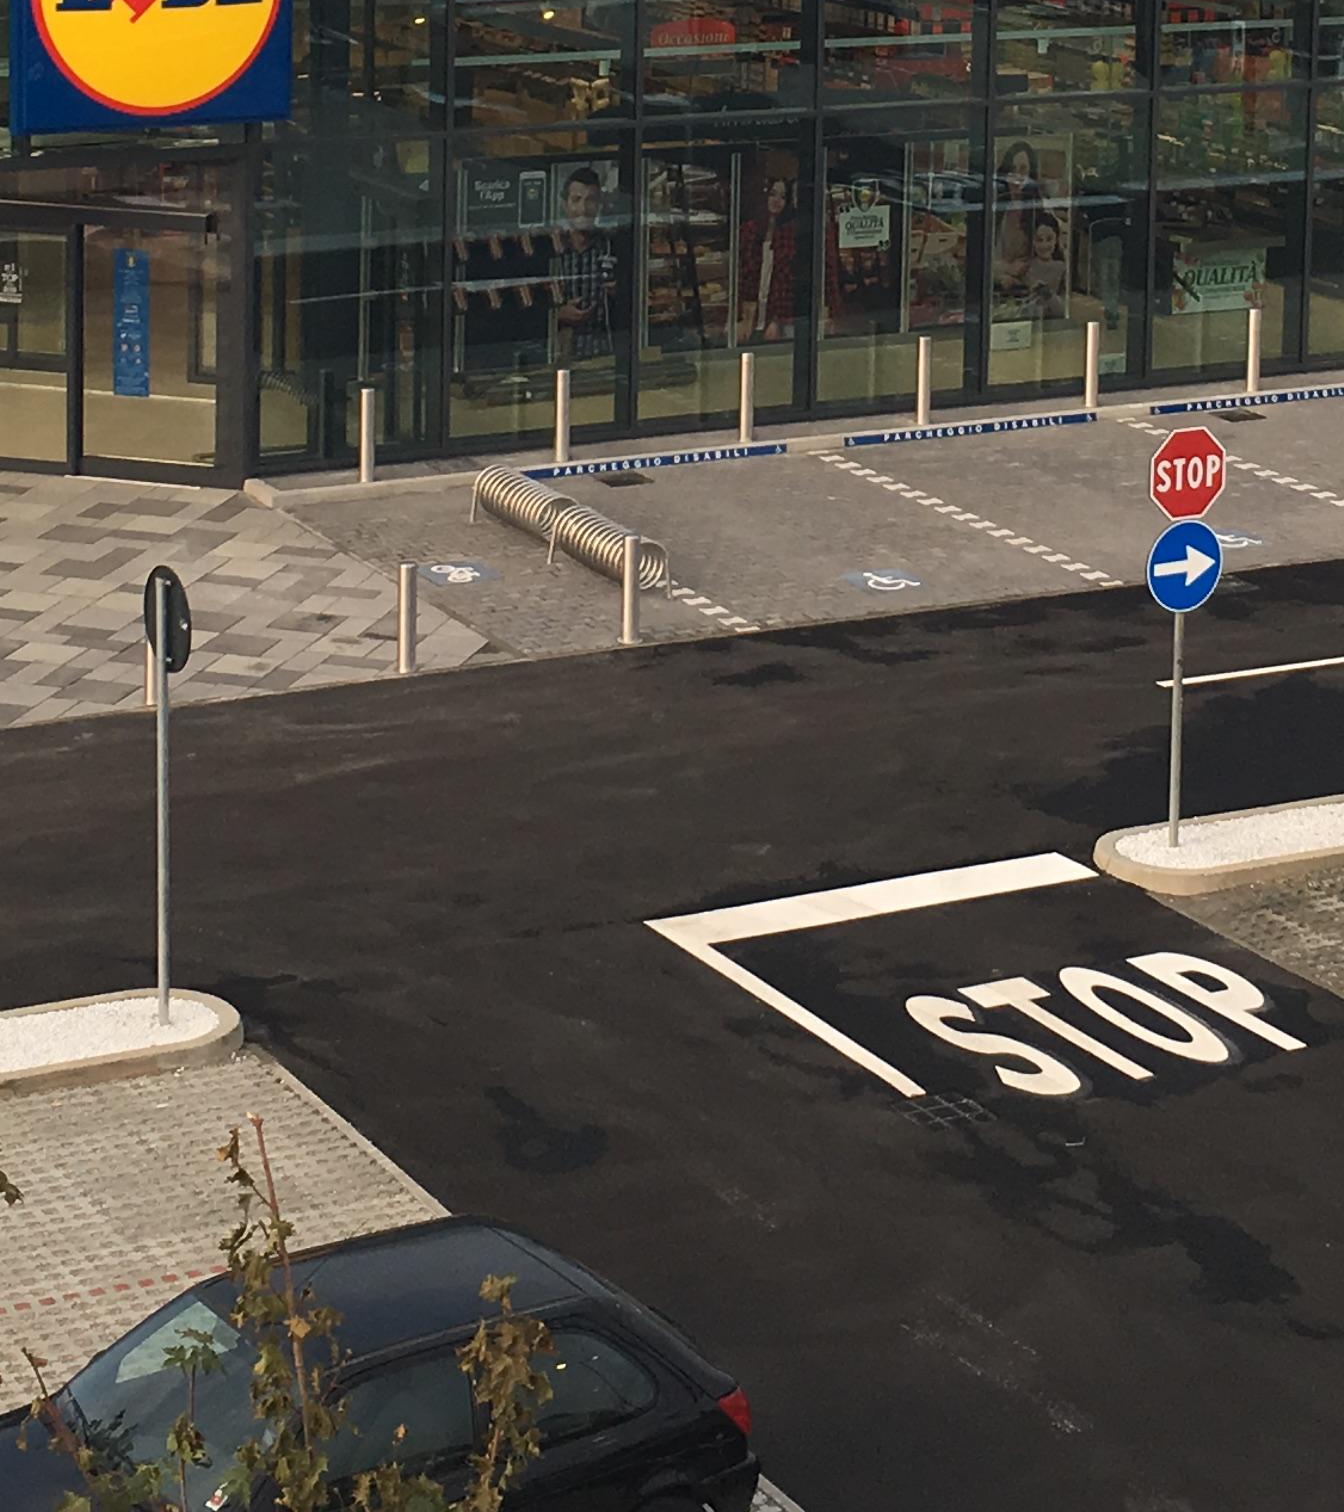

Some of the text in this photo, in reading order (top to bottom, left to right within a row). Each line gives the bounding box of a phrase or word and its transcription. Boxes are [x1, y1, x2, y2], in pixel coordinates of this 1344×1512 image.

[1186, 395, 1279, 411] PARCHEGGIO
[883, 416, 1064, 441] PARCHEGGIO DISABILI
[553, 448, 749, 476] PARCHEGGIO DISABILI
[1156, 454, 1221, 493] STOP
[905, 951, 1307, 1096] STOP
